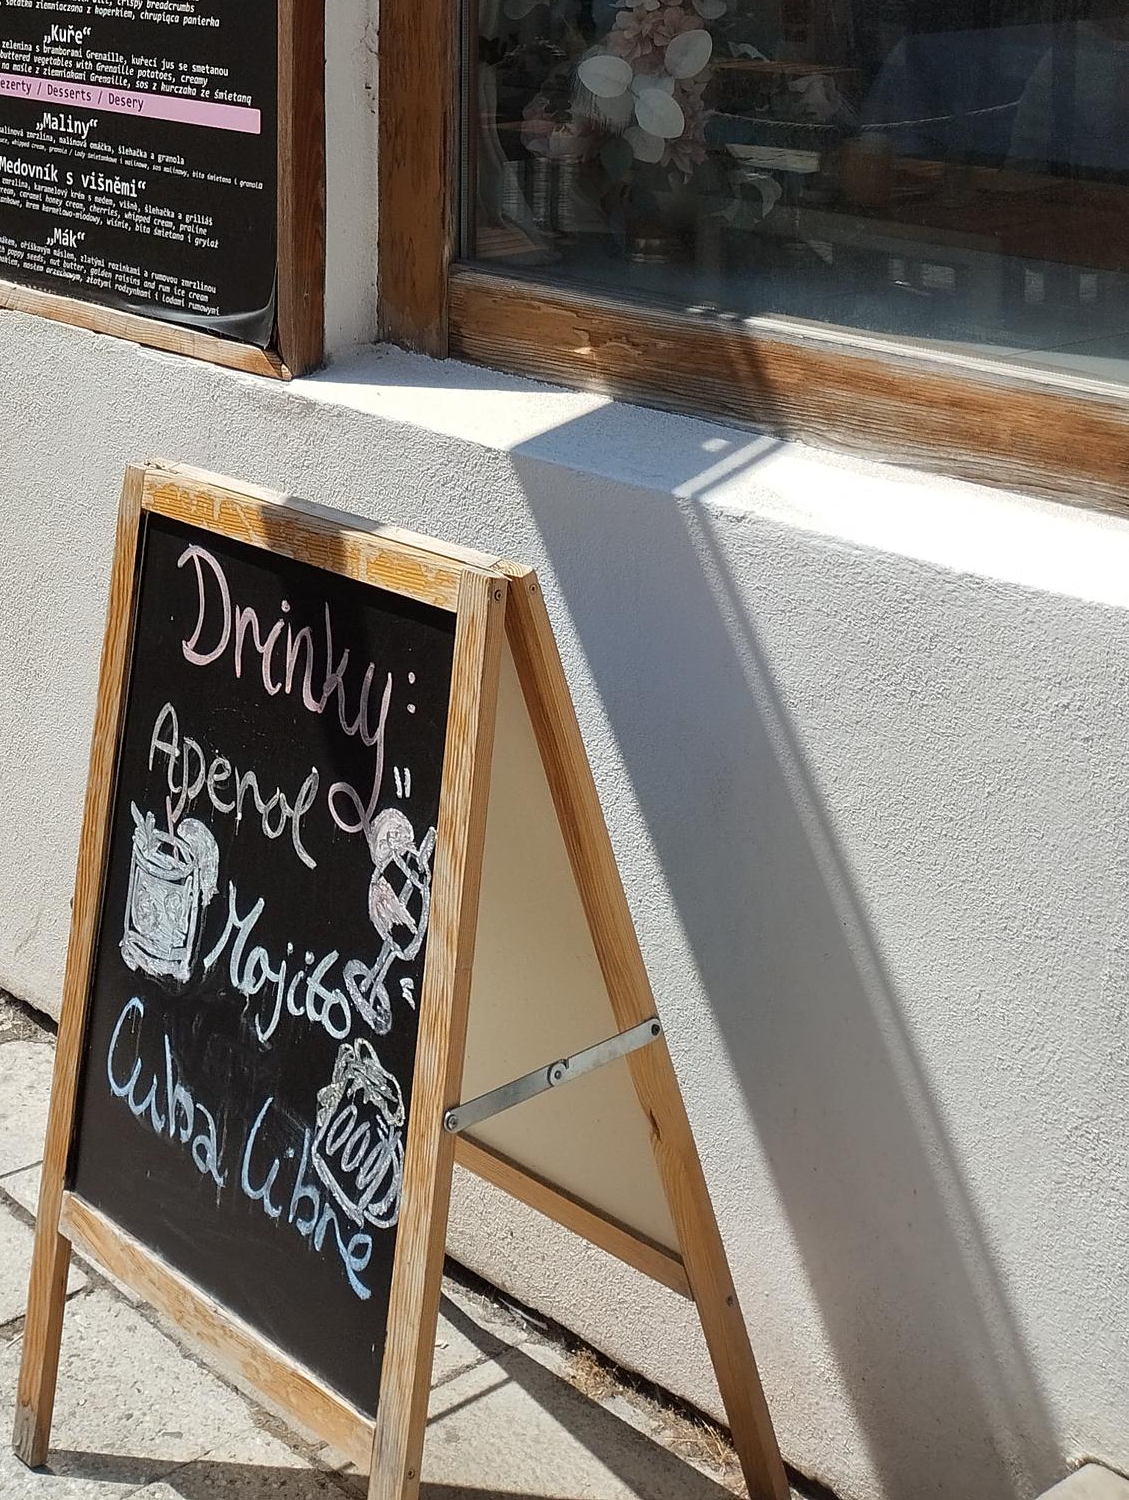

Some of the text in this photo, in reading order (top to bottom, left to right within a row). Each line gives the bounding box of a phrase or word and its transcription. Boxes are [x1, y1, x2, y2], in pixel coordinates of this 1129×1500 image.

[47, 84, 92, 101] Desserts
[109, 92, 144, 112] Desery
[148, 701, 320, 870] Aperol
[203, 880, 351, 1043] Mojito
[107, 996, 227, 1188] Cuba
